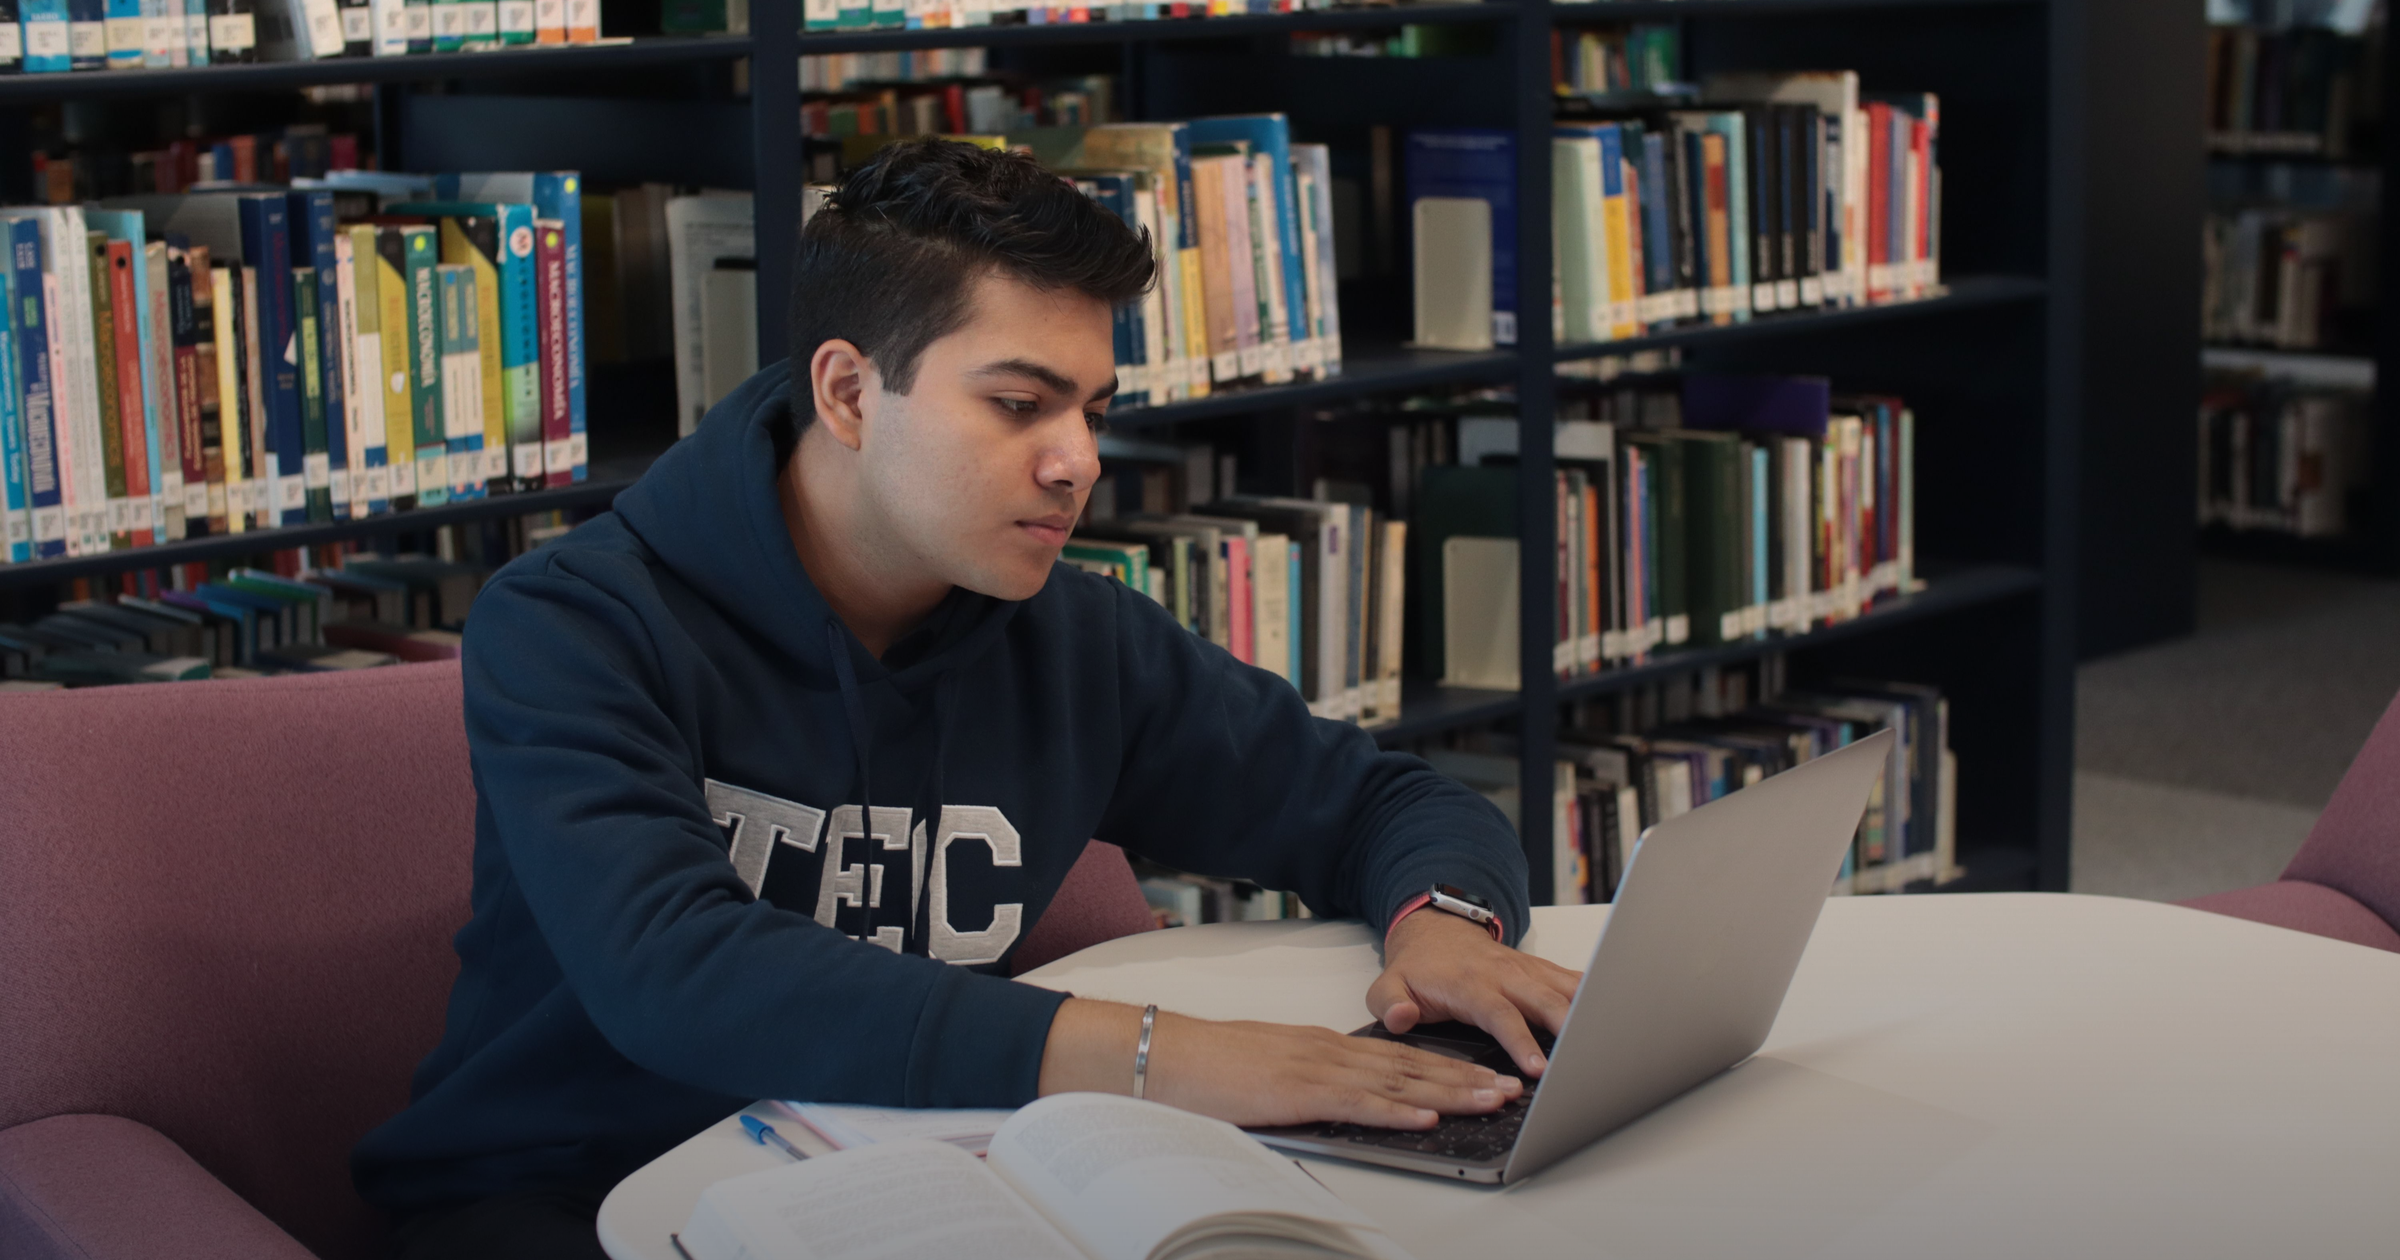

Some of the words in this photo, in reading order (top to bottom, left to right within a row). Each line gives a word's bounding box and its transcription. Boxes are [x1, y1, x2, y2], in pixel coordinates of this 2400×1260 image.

[98, 310, 122, 467] Macroeconomics
[153, 290, 177, 461] Macroeconomics
[415, 266, 437, 388] MACROECONOMÍA
[548, 260, 565, 420] MACROECONOMÍA
[1, 331, 14, 412] Macroeconomic
[9, 451, 21, 484] Today
[704, 778, 1024, 966] TEC
